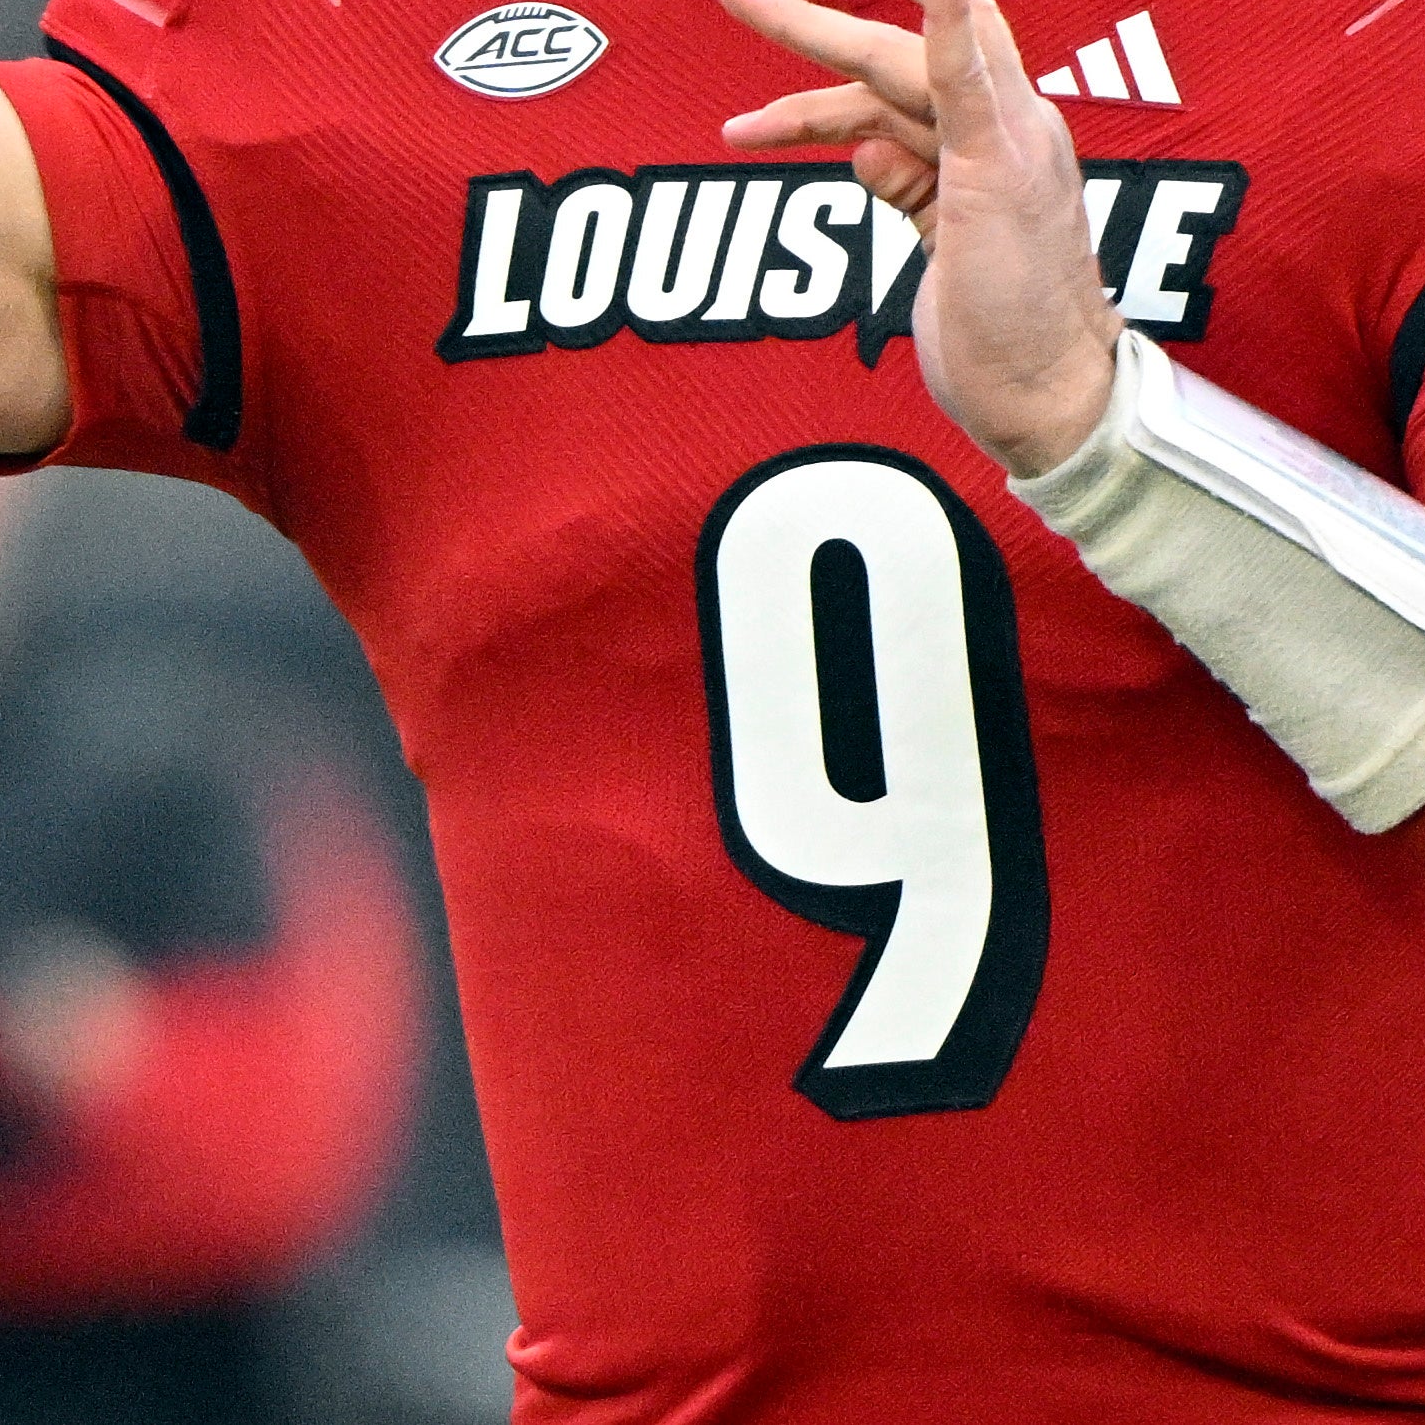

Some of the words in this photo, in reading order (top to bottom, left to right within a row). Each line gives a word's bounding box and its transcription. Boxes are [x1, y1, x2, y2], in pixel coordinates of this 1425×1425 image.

[464, 24, 580, 63] ACC
[451, 169, 1235, 349] LOUISVE
[707, 453, 1015, 1090] 9
